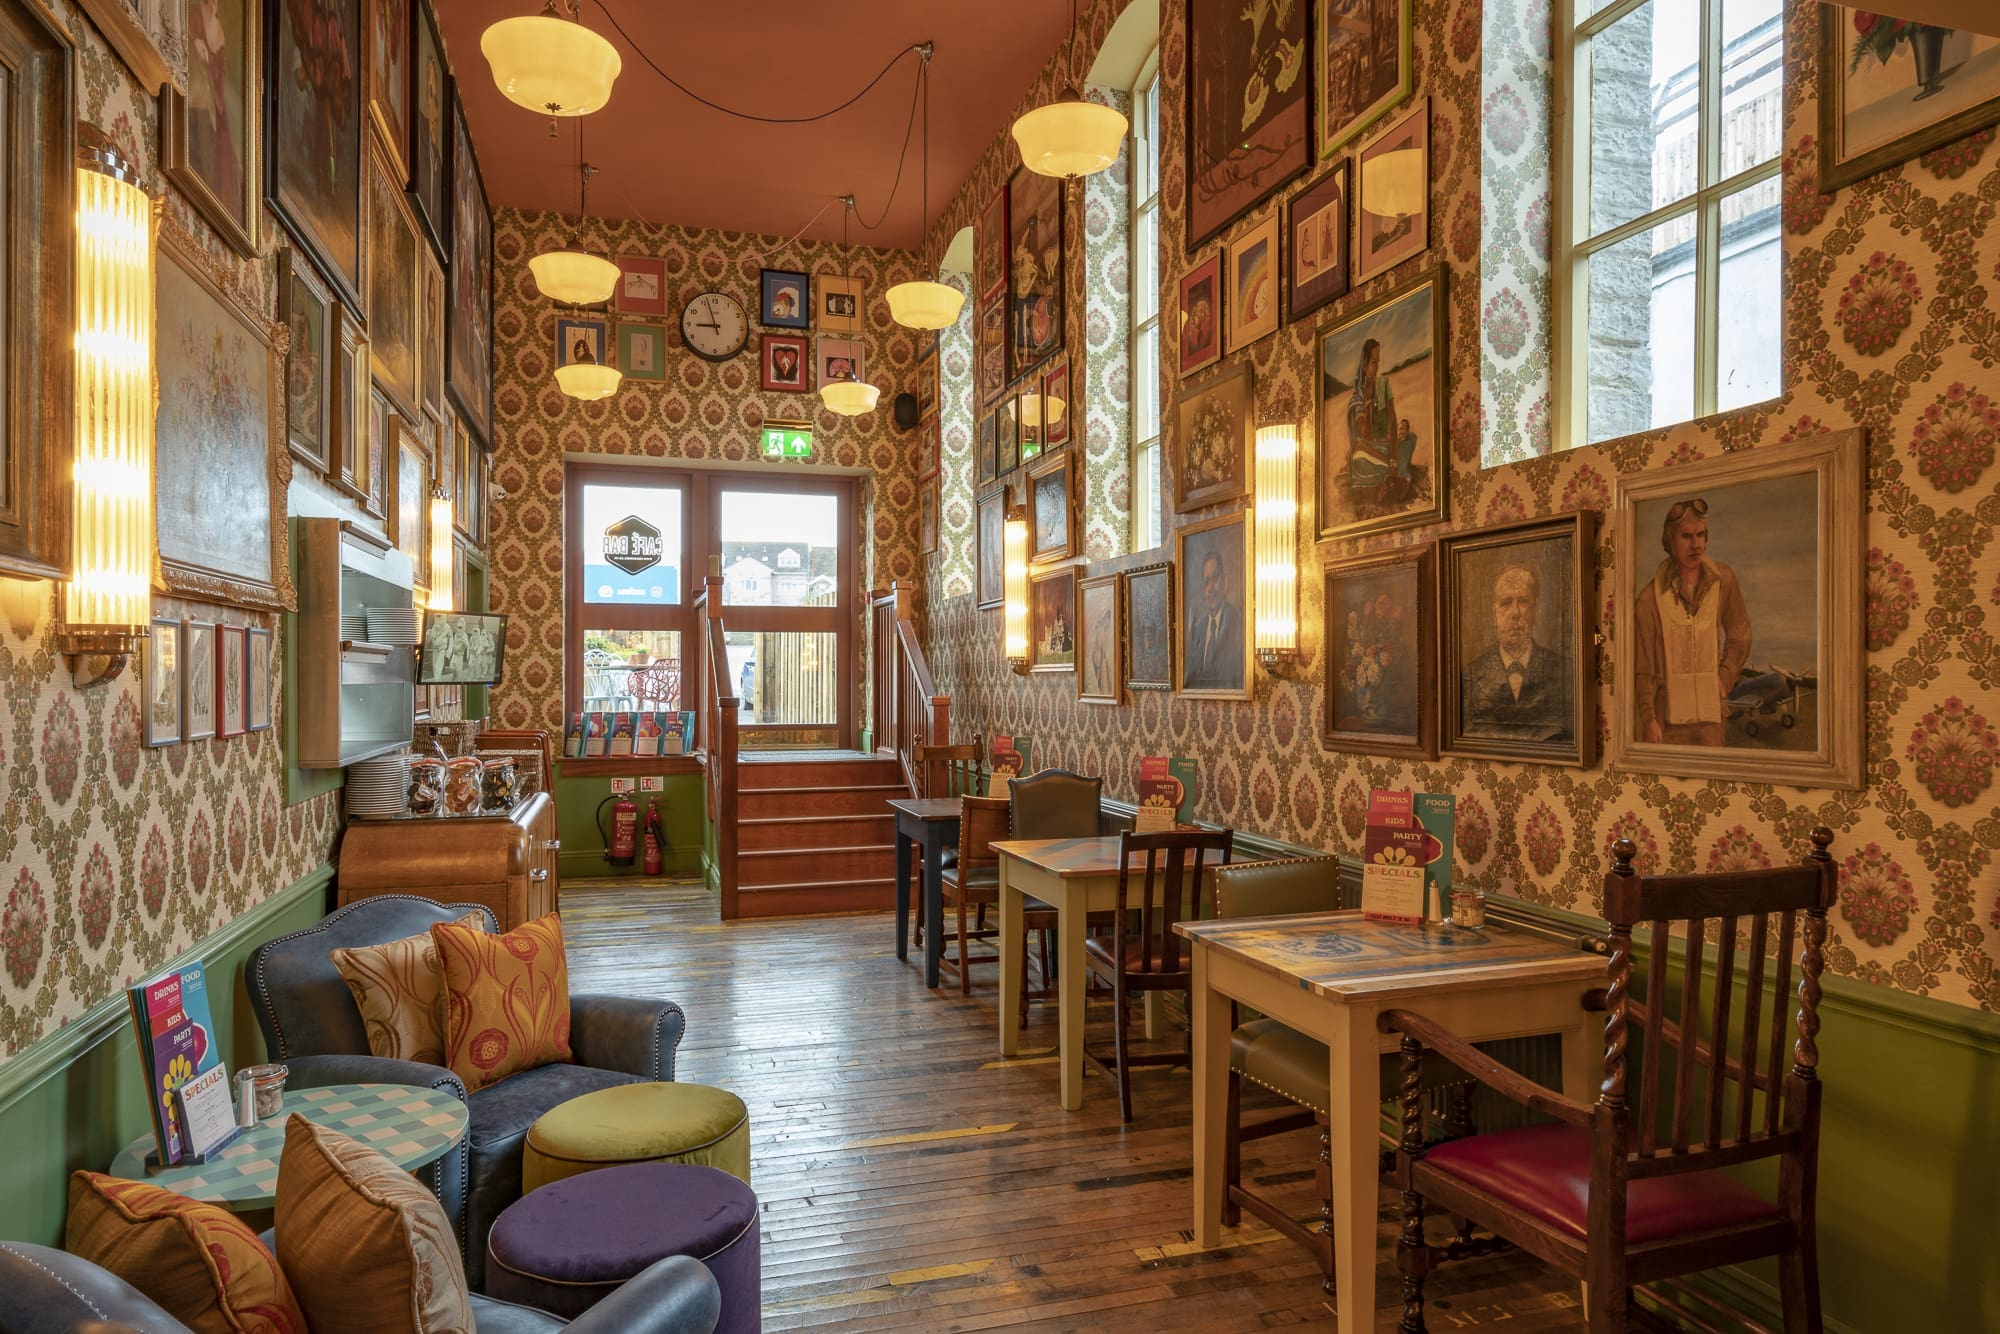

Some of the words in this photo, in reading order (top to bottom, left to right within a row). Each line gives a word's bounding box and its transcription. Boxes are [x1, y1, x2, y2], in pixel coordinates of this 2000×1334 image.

[1376, 795, 1409, 804] DRINKS
[1425, 799, 1450, 807] FOOD
[1384, 817, 1406, 825] KIDS
[1393, 832, 1422, 841] PARTY
[1367, 866, 1421, 879] SPECIALS
[180, 969, 201, 985] FOOD
[154, 981, 179, 1001] DRINKS
[167, 1012, 182, 1028] KIDS
[173, 1026, 192, 1045] PARTY
[184, 1068, 224, 1102] SPECIALS
